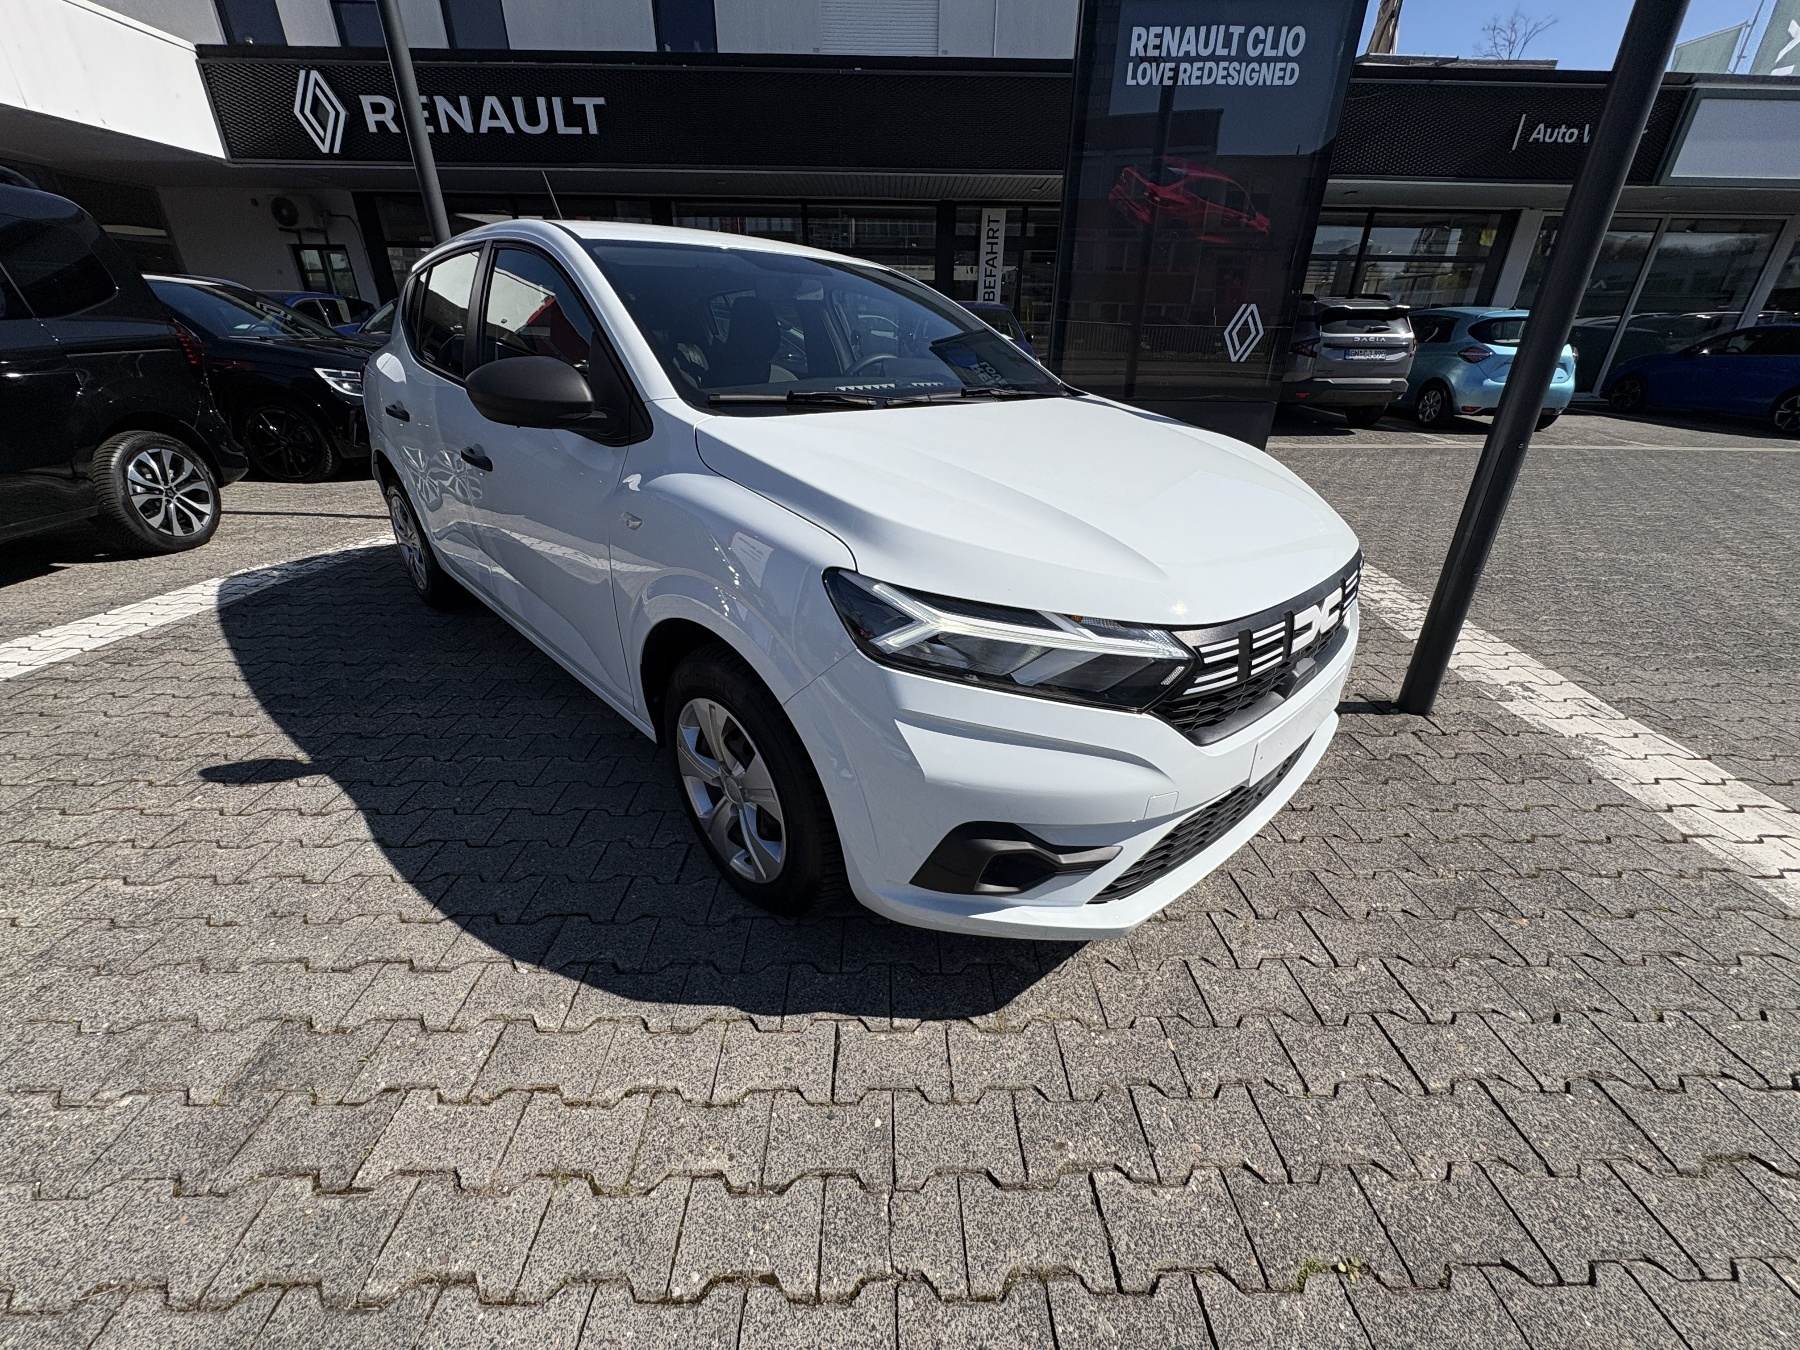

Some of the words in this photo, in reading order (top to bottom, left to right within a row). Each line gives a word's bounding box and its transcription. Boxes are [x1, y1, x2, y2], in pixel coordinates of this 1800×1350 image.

[1129, 25, 1245, 57] RENAULT
[1246, 25, 1306, 57] CLIO
[1126, 62, 1176, 86] LOVE
[1177, 61, 1300, 86] REDESIGNED
[1528, 123, 1579, 143] Auto
